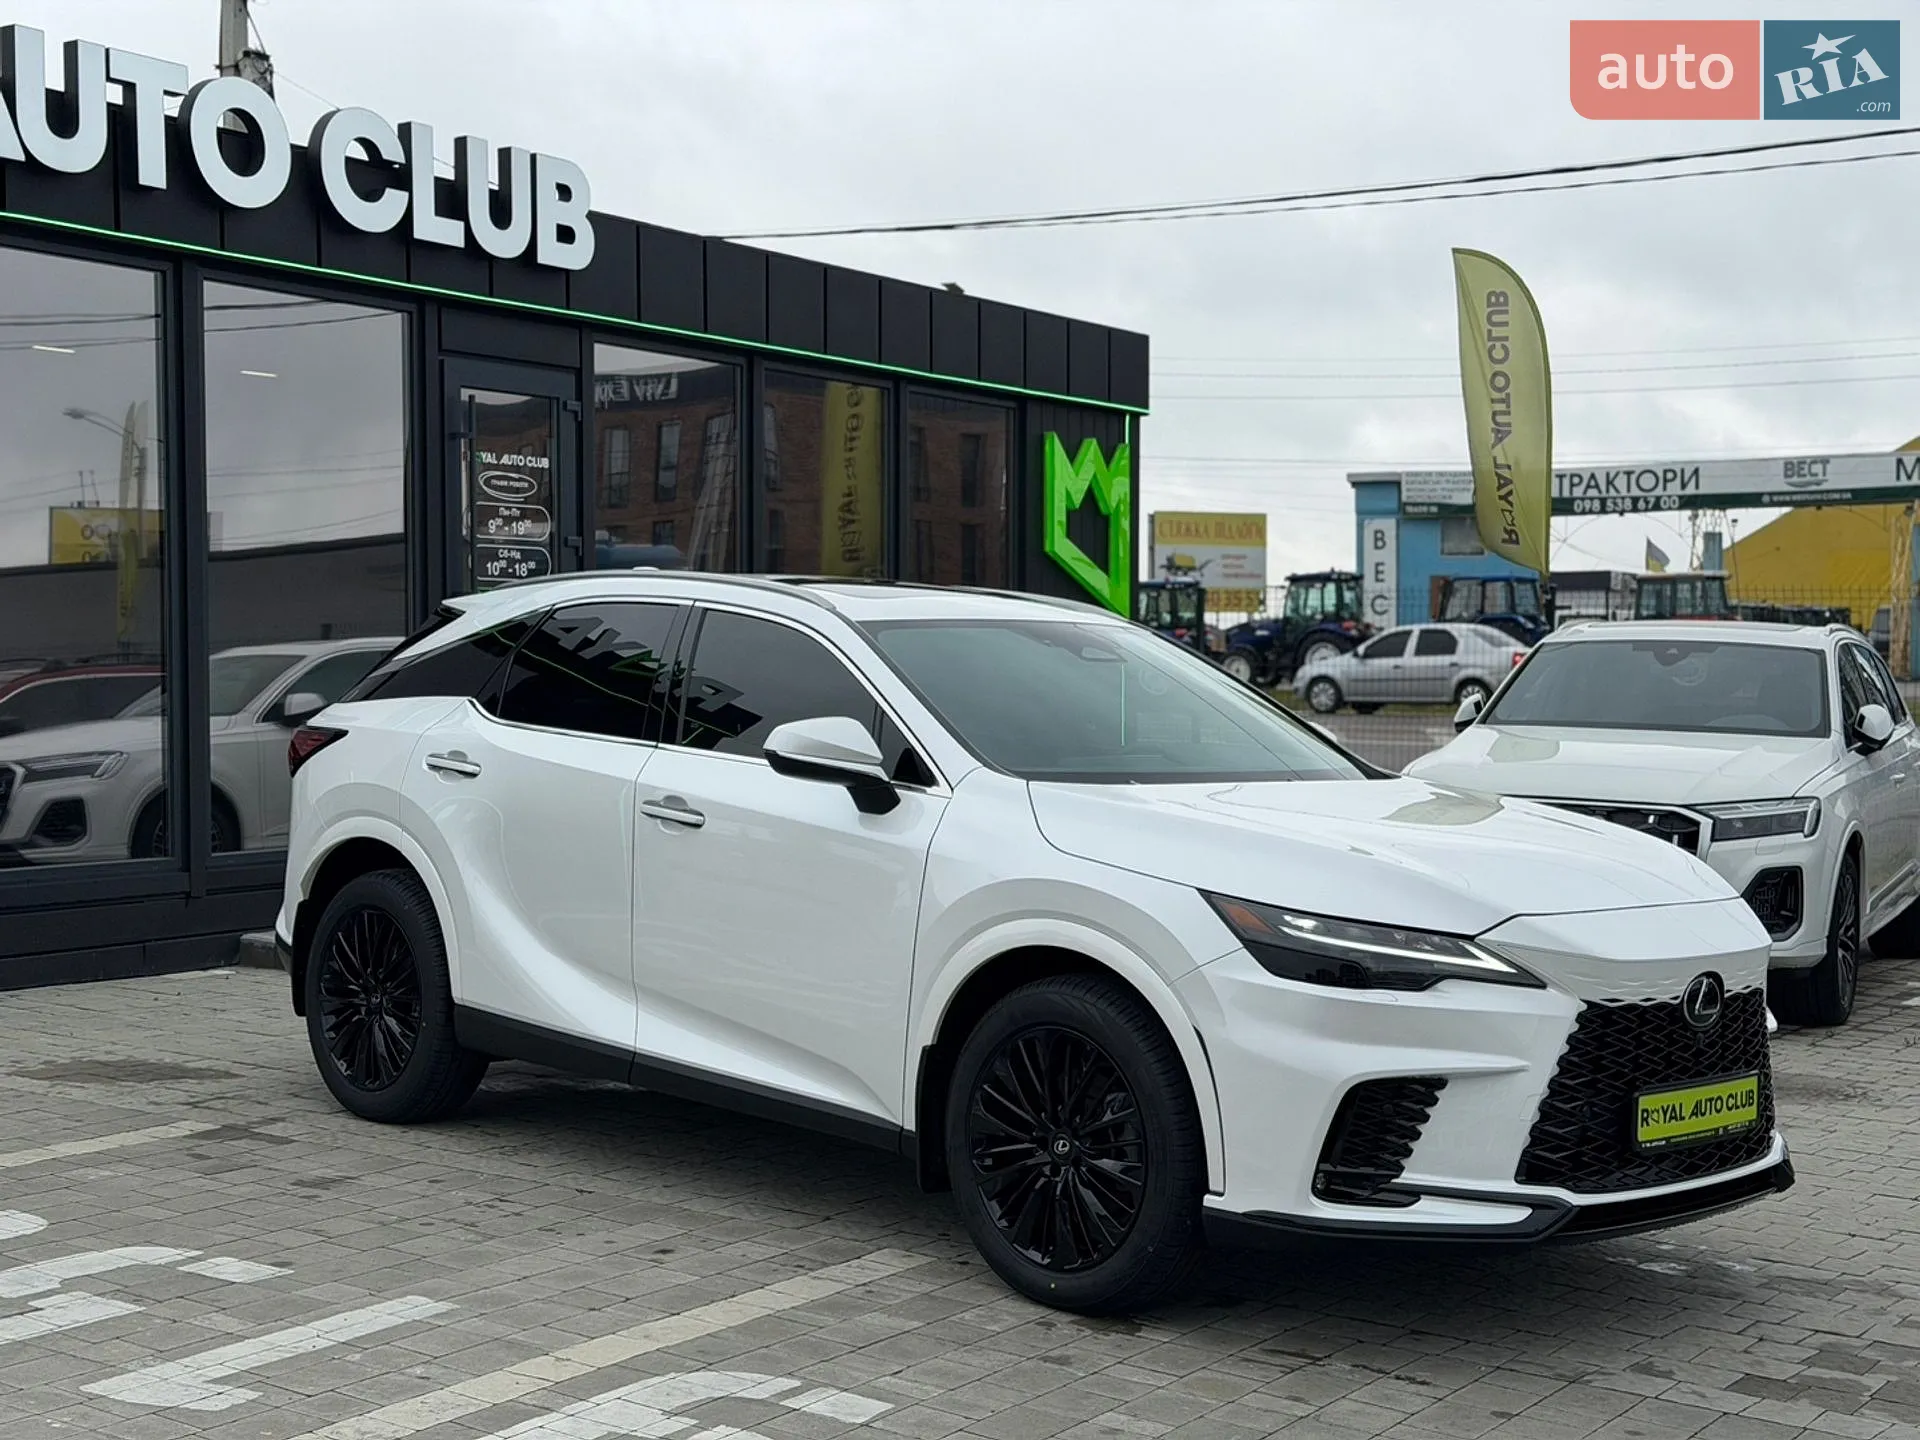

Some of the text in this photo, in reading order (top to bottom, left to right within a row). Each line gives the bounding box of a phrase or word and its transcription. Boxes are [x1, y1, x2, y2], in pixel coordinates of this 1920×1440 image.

[313, 106, 595, 271] CLUB
[500, 454, 525, 467] AUTO
[526, 456, 549, 468] CLUB
[1783, 459, 1830, 479] ВЕСТ
[1555, 466, 1700, 497] ТРАКТОРИ
[1573, 495, 1680, 513] 098 538 67 00
[1371, 529, 1389, 633] ВЕС
[1688, 1095, 1723, 1120] AUTO
[1726, 1089, 1755, 1112] CLUB
